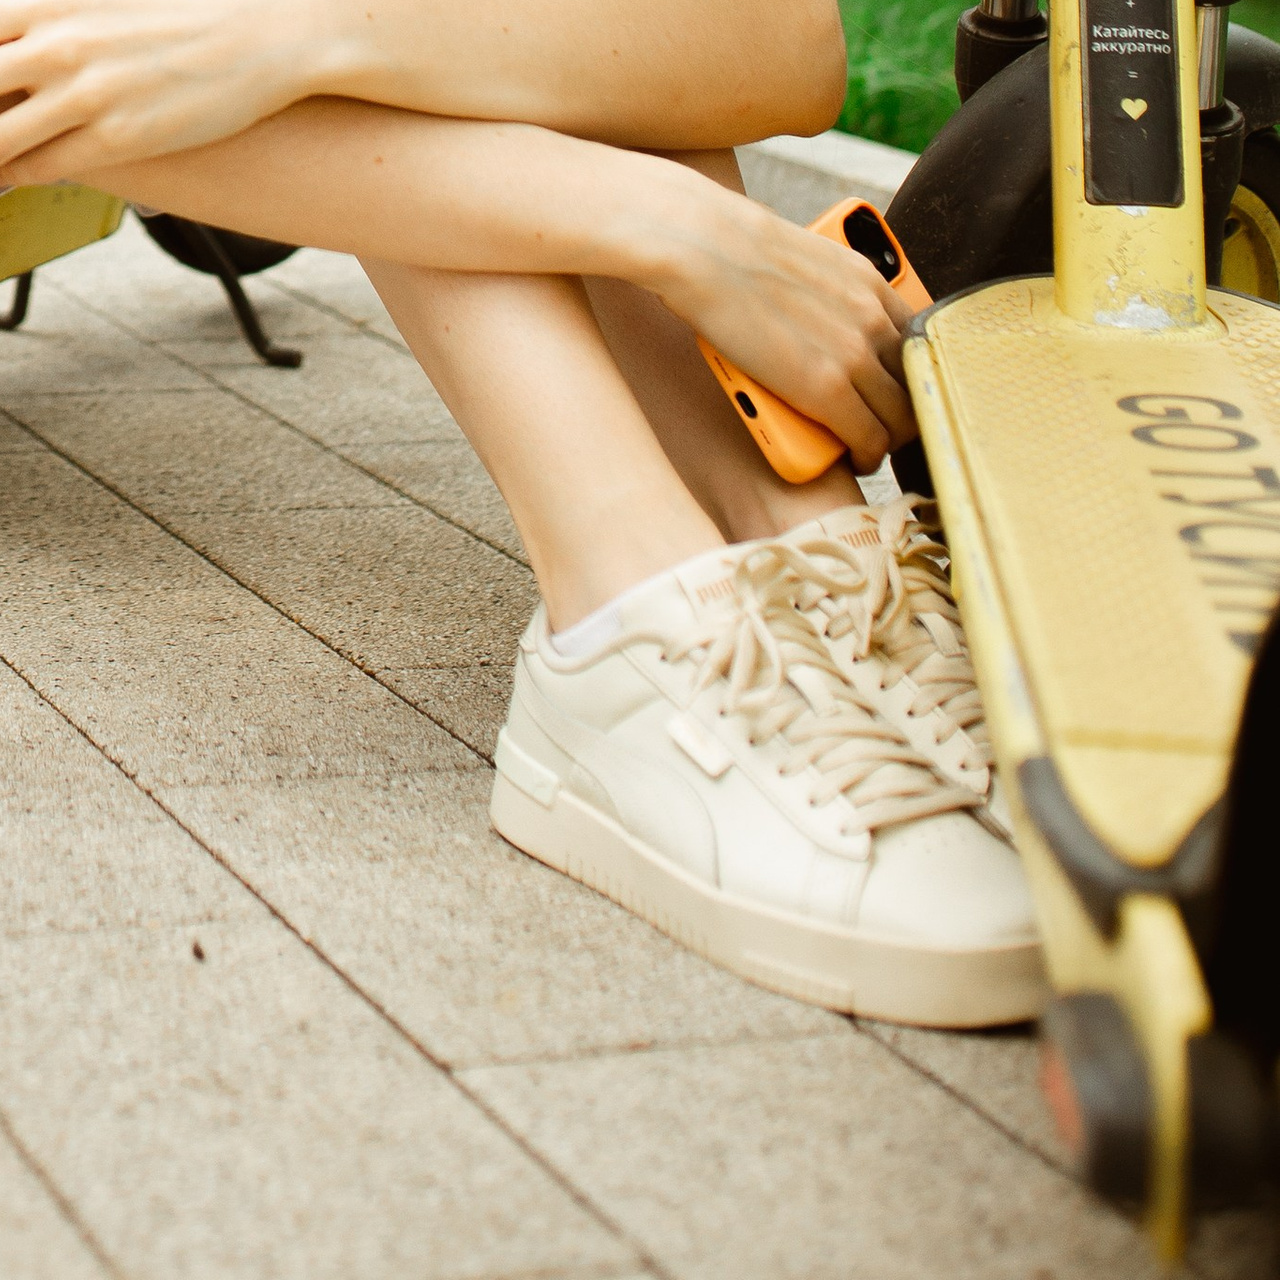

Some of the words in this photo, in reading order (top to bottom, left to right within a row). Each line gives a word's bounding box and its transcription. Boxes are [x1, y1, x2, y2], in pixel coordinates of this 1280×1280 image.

[1092, 24, 1170, 40] Катайтесь
[1091, 42, 1171, 55] аккуратно
[1116, 393, 1260, 453] GO
